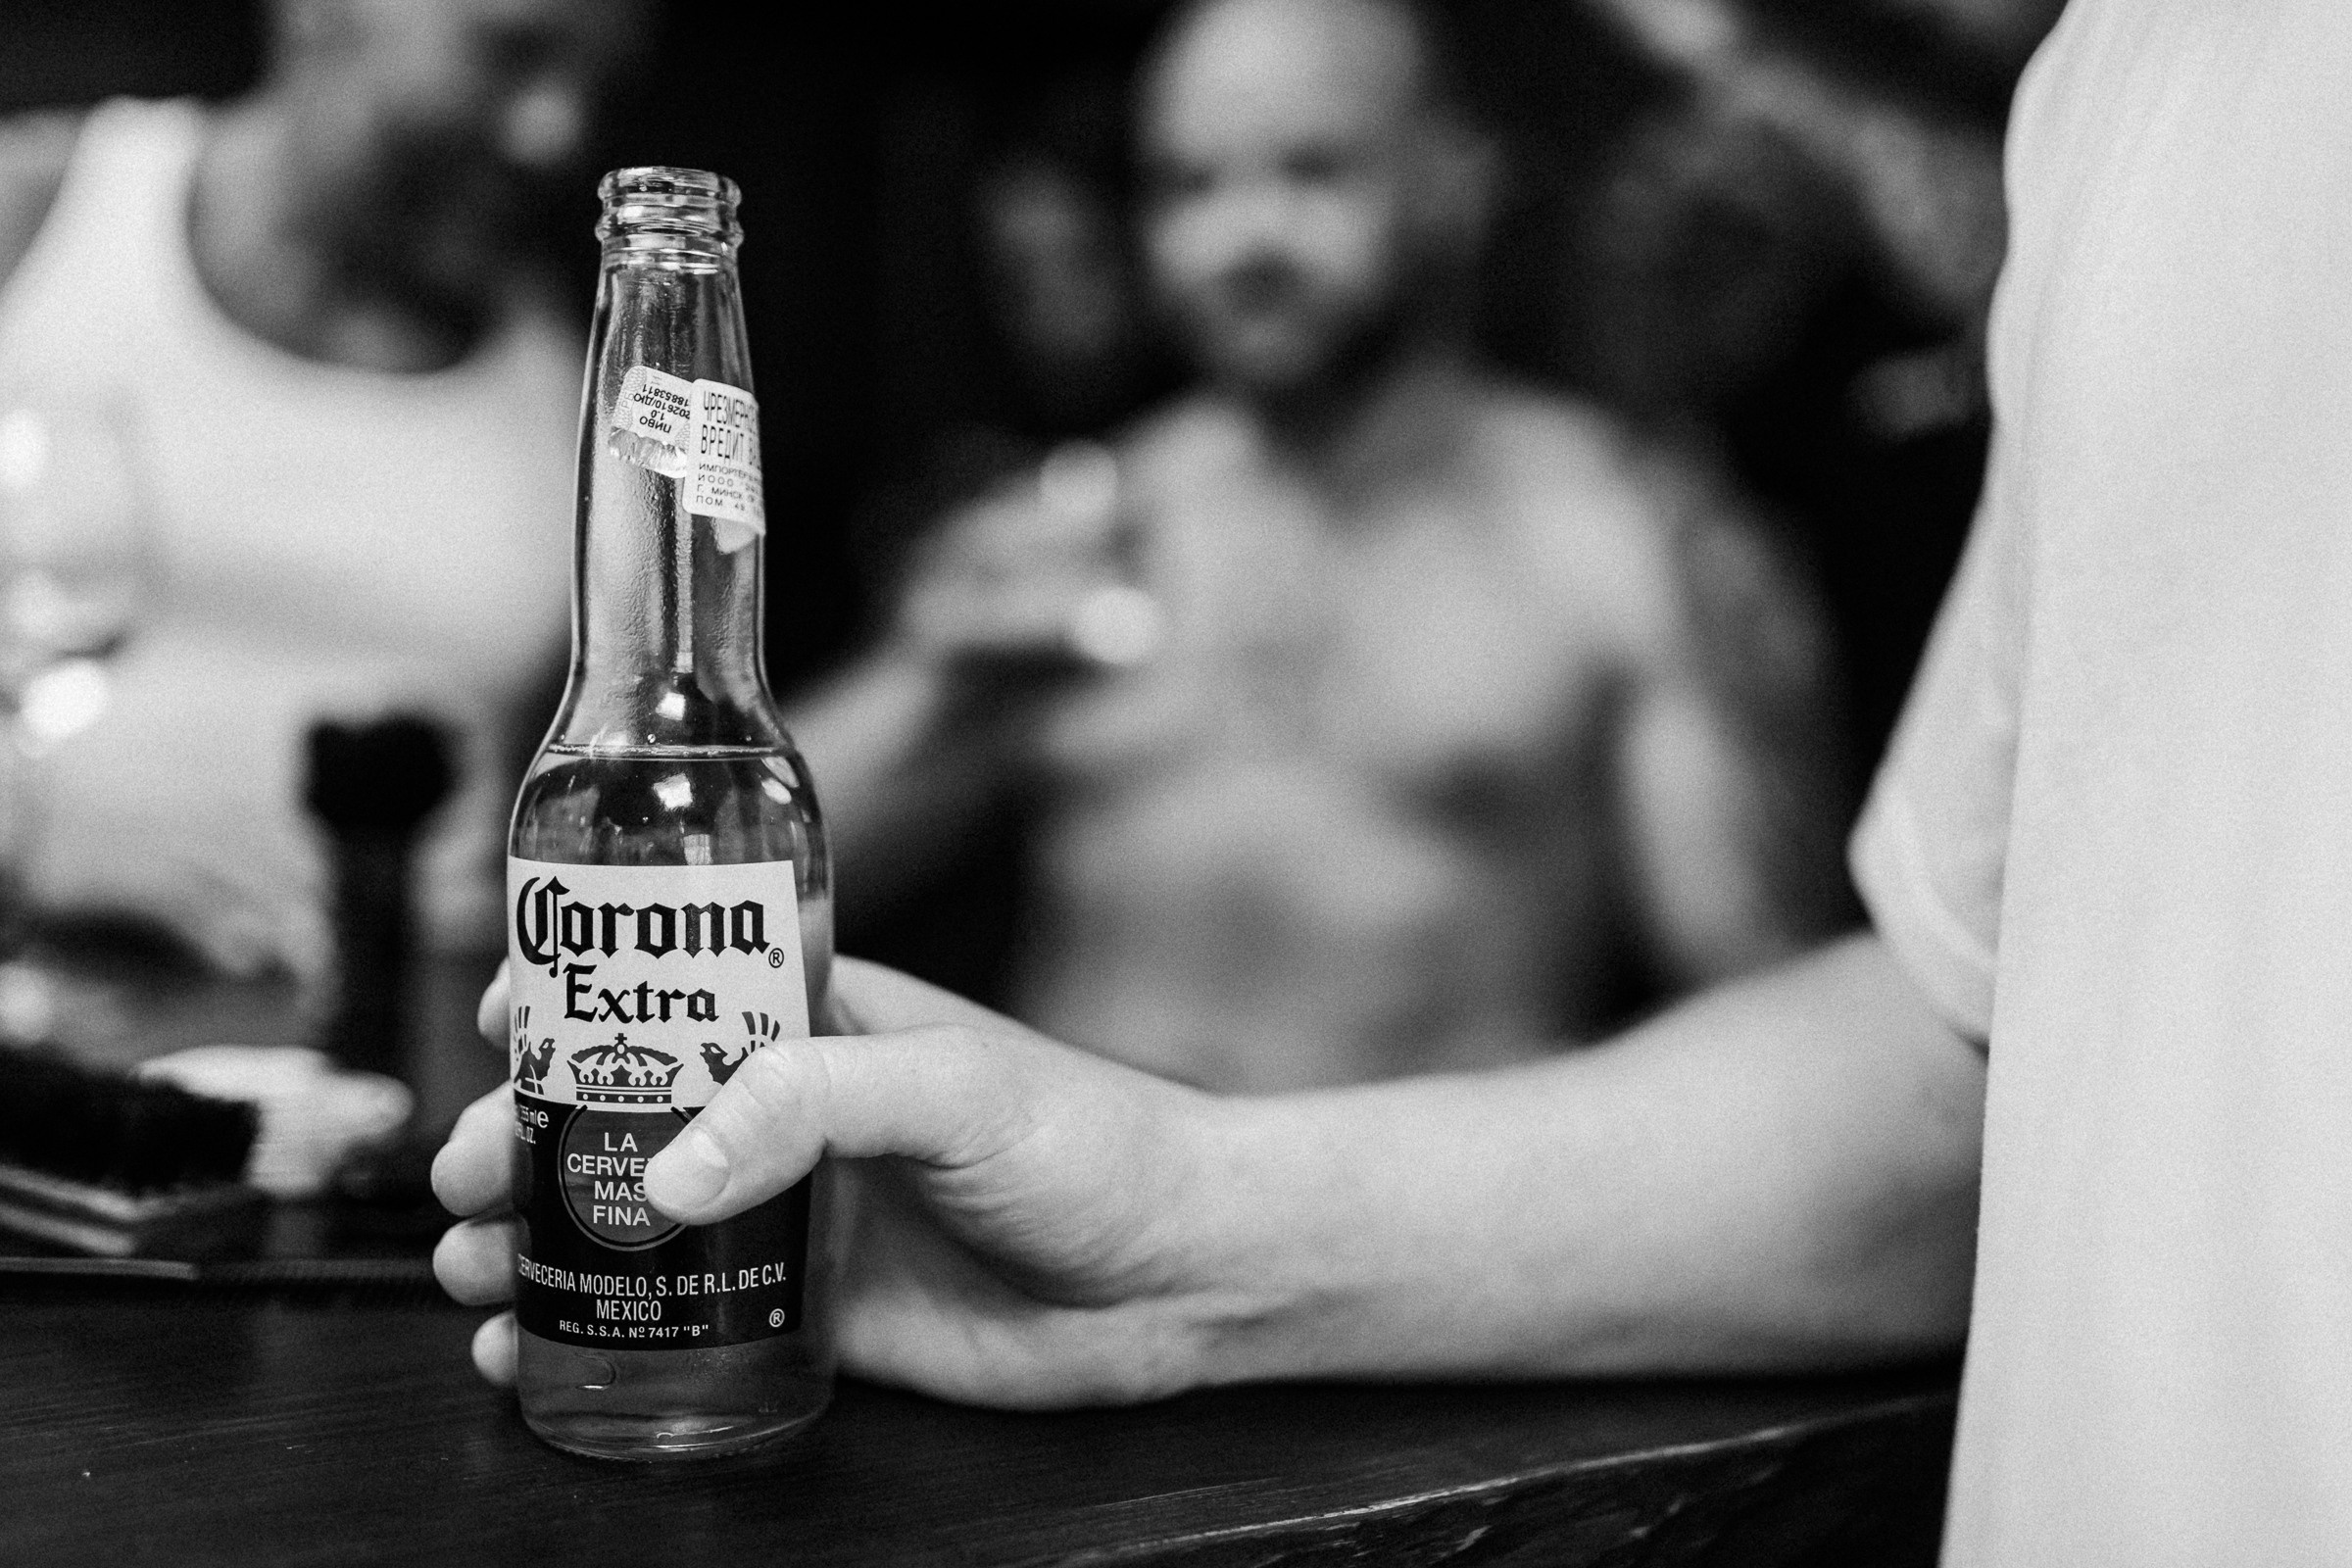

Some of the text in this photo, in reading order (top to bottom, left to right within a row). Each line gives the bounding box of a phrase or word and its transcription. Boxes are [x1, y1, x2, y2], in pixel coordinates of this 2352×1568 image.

[639, 416, 672, 433] ПИВО
[651, 410, 665, 421] 1.0
[701, 424, 744, 466] ВРЕДИТ
[515, 875, 770, 978] Corona
[563, 962, 719, 1023] Extra
[604, 1132, 638, 1152] LA
[566, 1152, 652, 1176] CERVE
[594, 1181, 649, 1201] MAS
[593, 1205, 651, 1227] FINA
[579, 1272, 653, 1300] MODELO,
[656, 1275, 672, 1297] S.
[676, 1274, 699, 1296] DE
[738, 1267, 760, 1290] DE
[761, 1261, 786, 1286] C.V.
[596, 1298, 662, 1321] MEXICO
[559, 1320, 584, 1334] REG.
[648, 1326, 679, 1339] 7417
[683, 1323, 710, 1338] "B"
